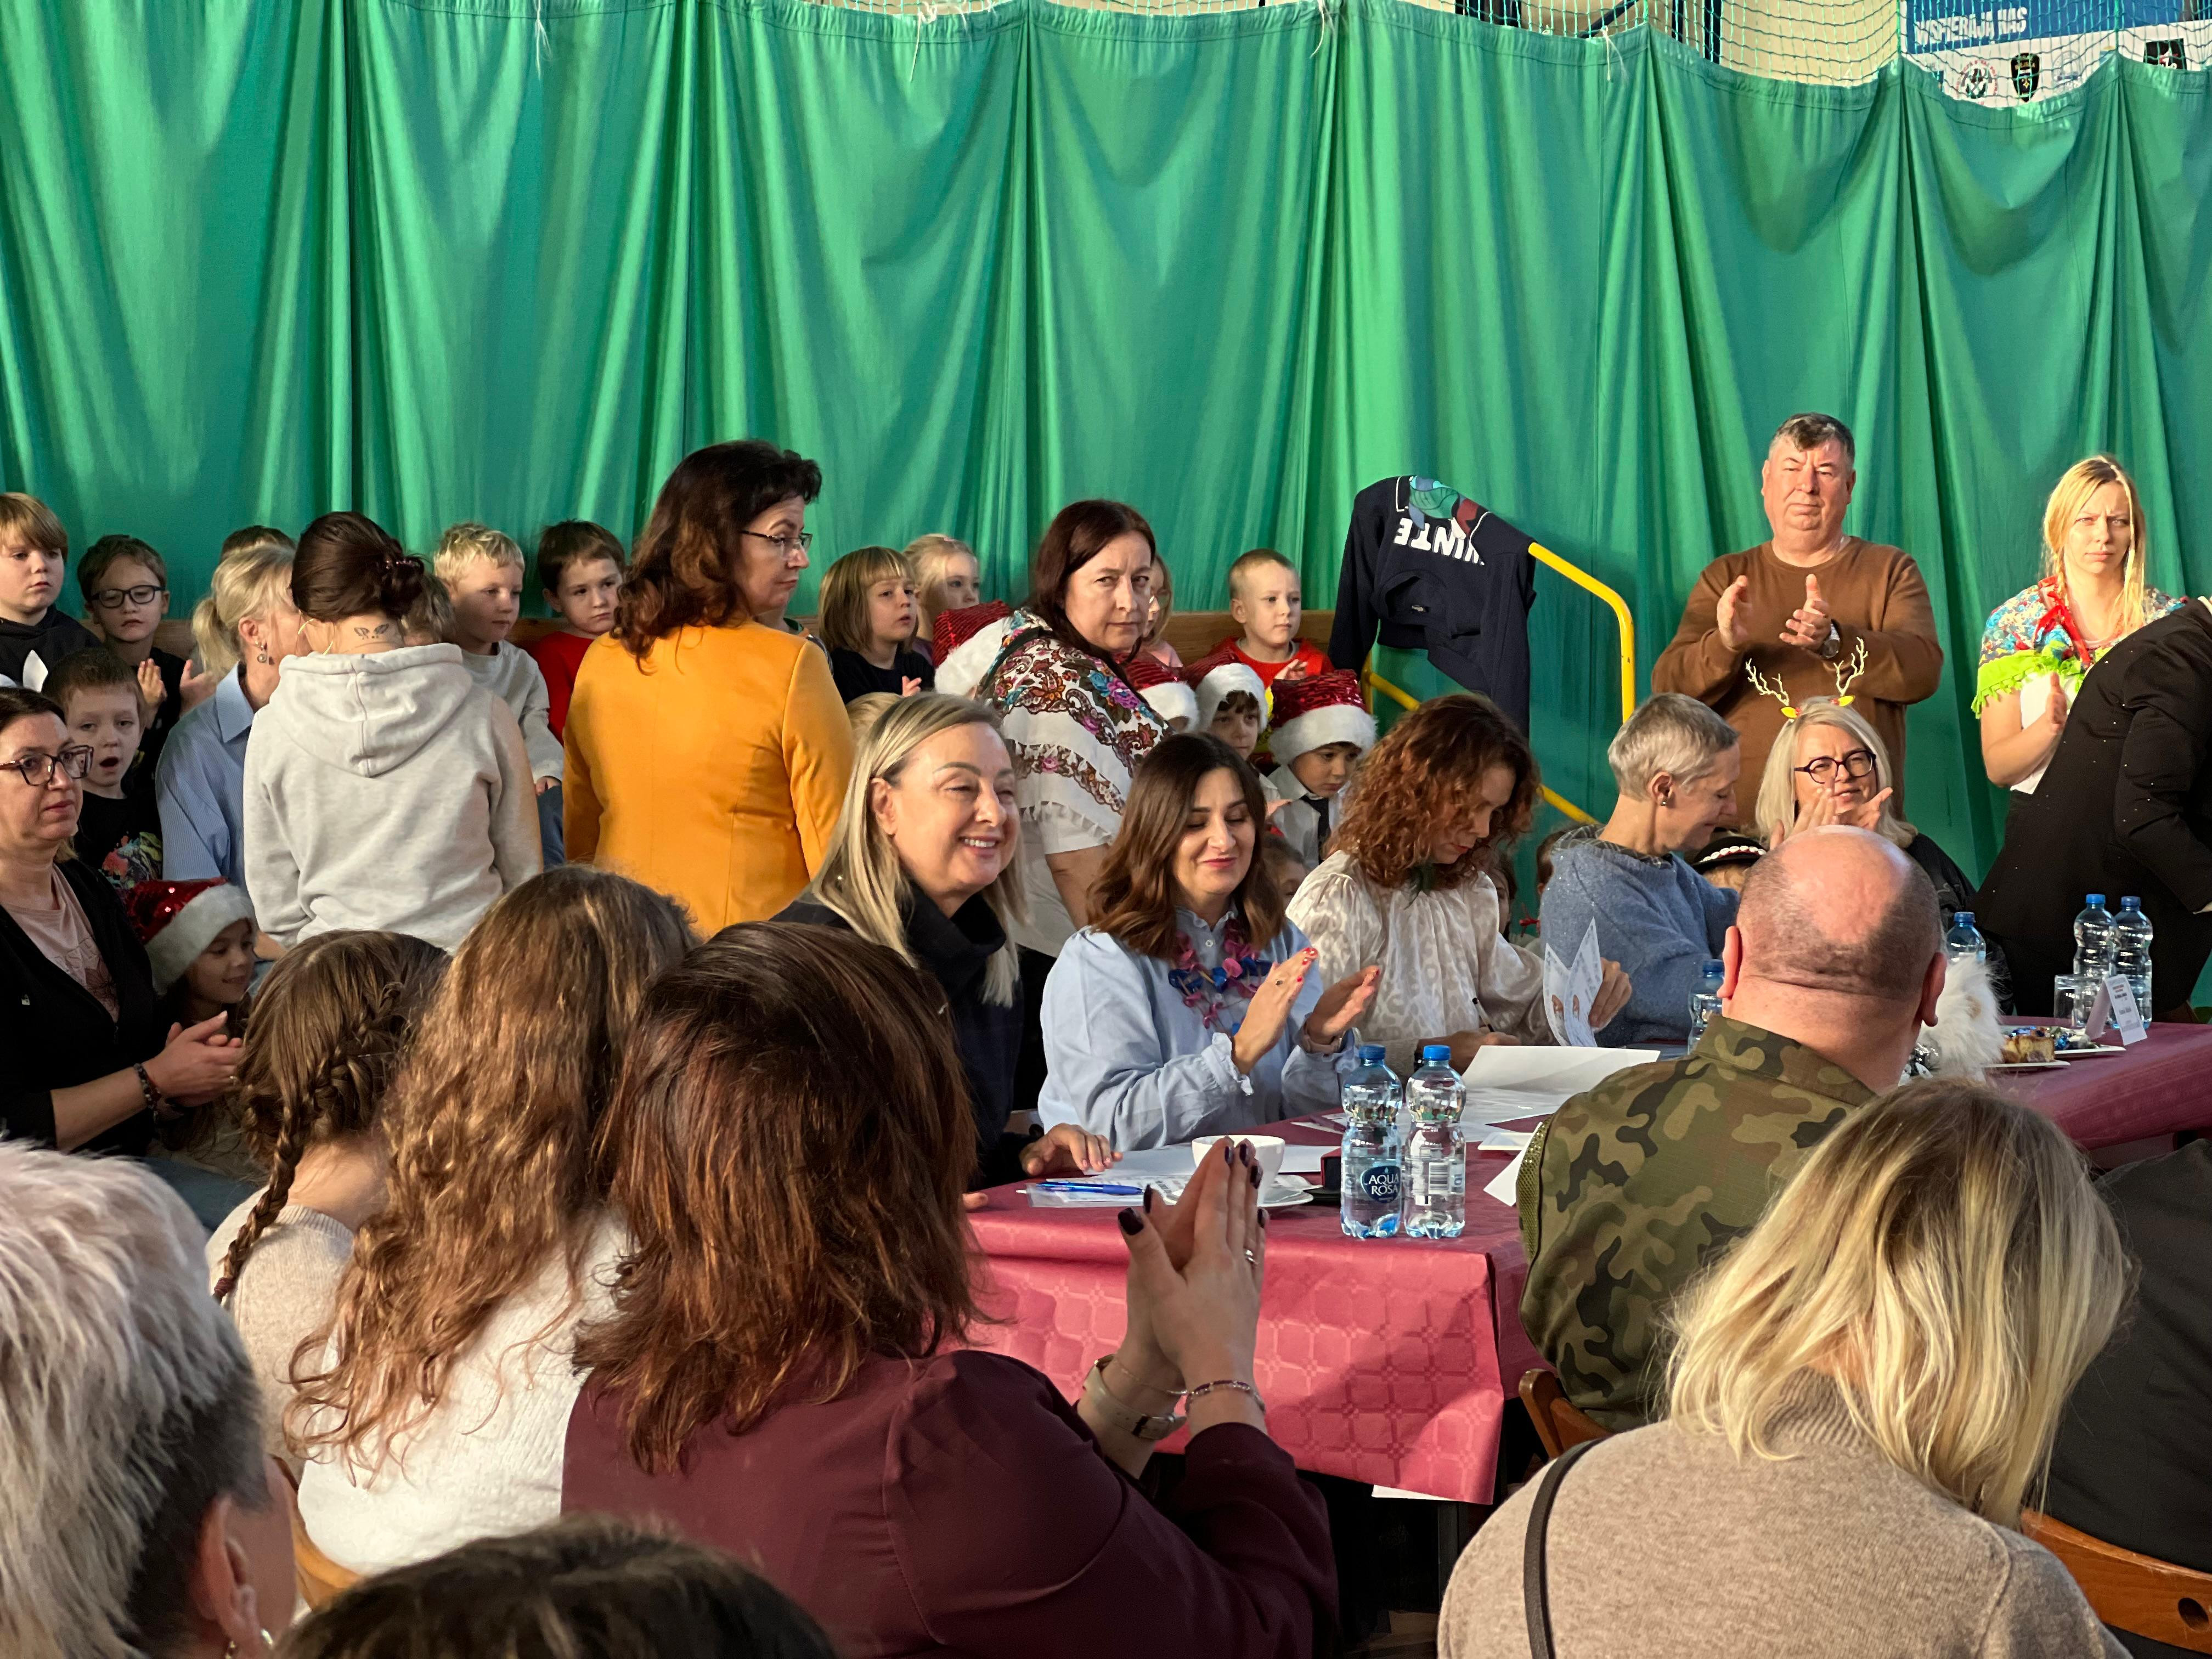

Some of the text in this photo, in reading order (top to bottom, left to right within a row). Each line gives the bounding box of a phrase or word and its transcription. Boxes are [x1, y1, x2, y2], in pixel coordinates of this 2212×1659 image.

[1997, 7, 2028, 35] NAS
[1368, 1173, 1398, 1186] AQUA
[1371, 1185, 1398, 1196] ROSA
